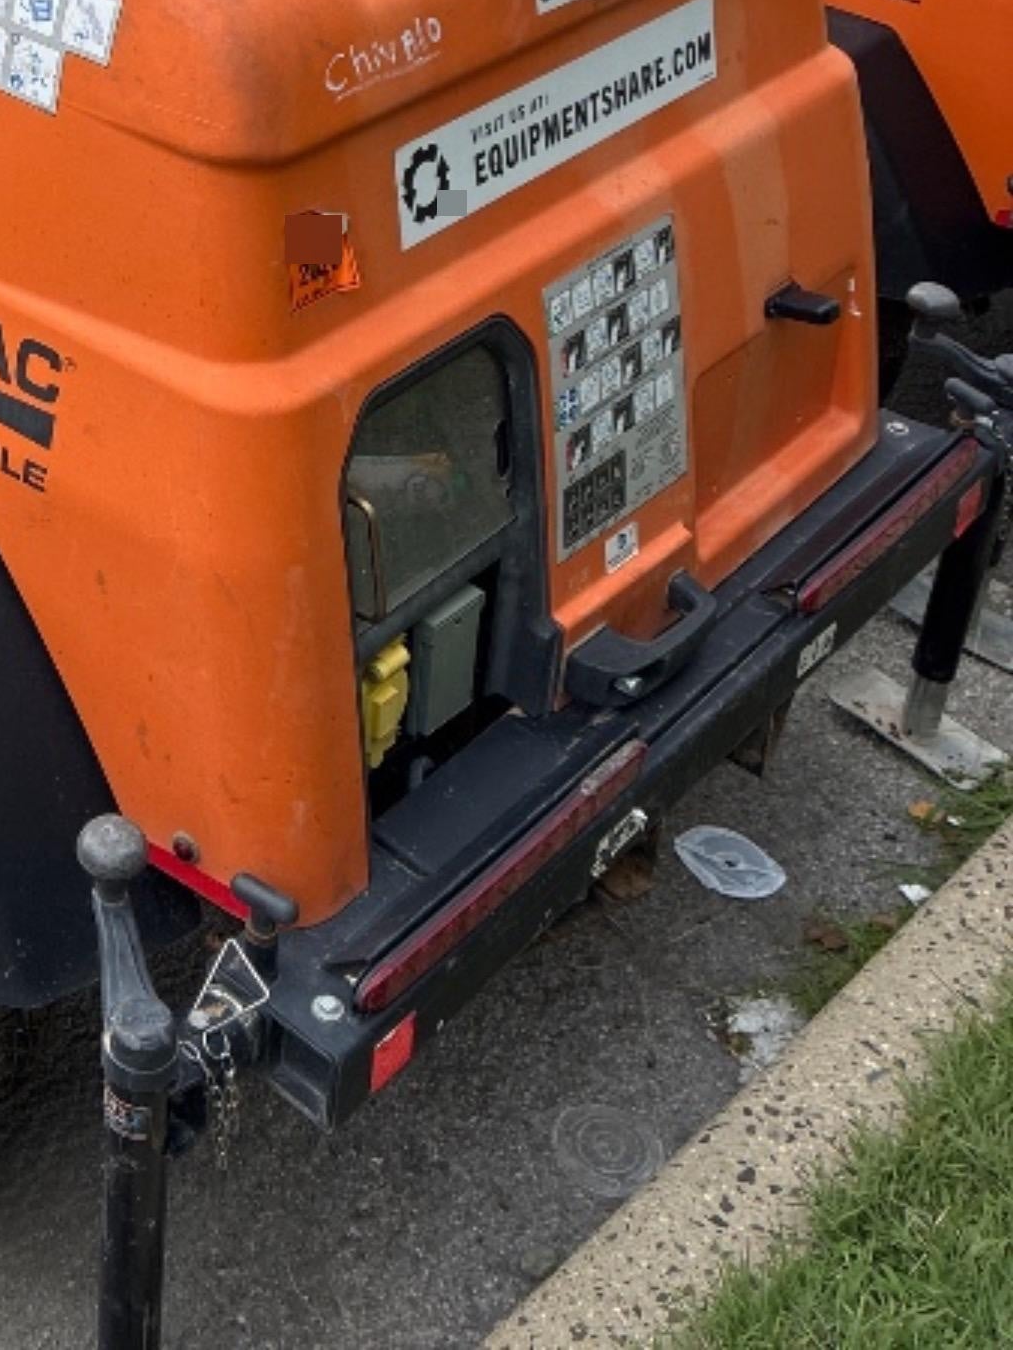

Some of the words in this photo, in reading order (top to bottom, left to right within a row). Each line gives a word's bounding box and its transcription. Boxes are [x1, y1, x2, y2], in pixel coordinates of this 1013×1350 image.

[471, 113, 504, 143] VISIT
[509, 103, 526, 124] US
[474, 32, 711, 187] EQUIPMENTSHARE.COM
